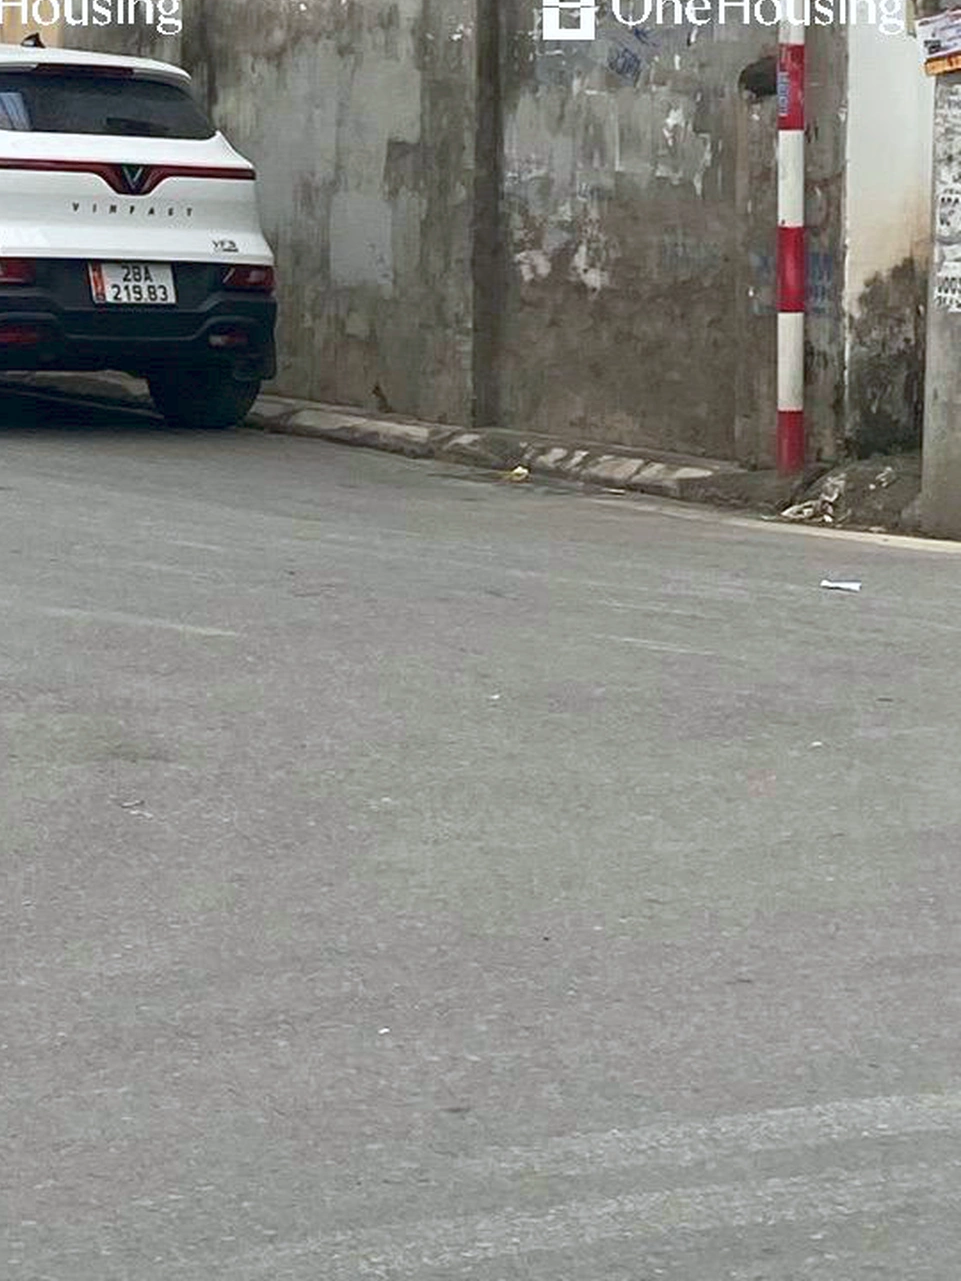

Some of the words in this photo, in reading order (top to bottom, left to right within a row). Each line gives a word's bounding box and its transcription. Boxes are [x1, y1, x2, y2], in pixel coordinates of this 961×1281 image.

[72, 202, 192, 217] VINFAST
[121, 265, 153, 283] 28A
[111, 284, 169, 302] 219.83
